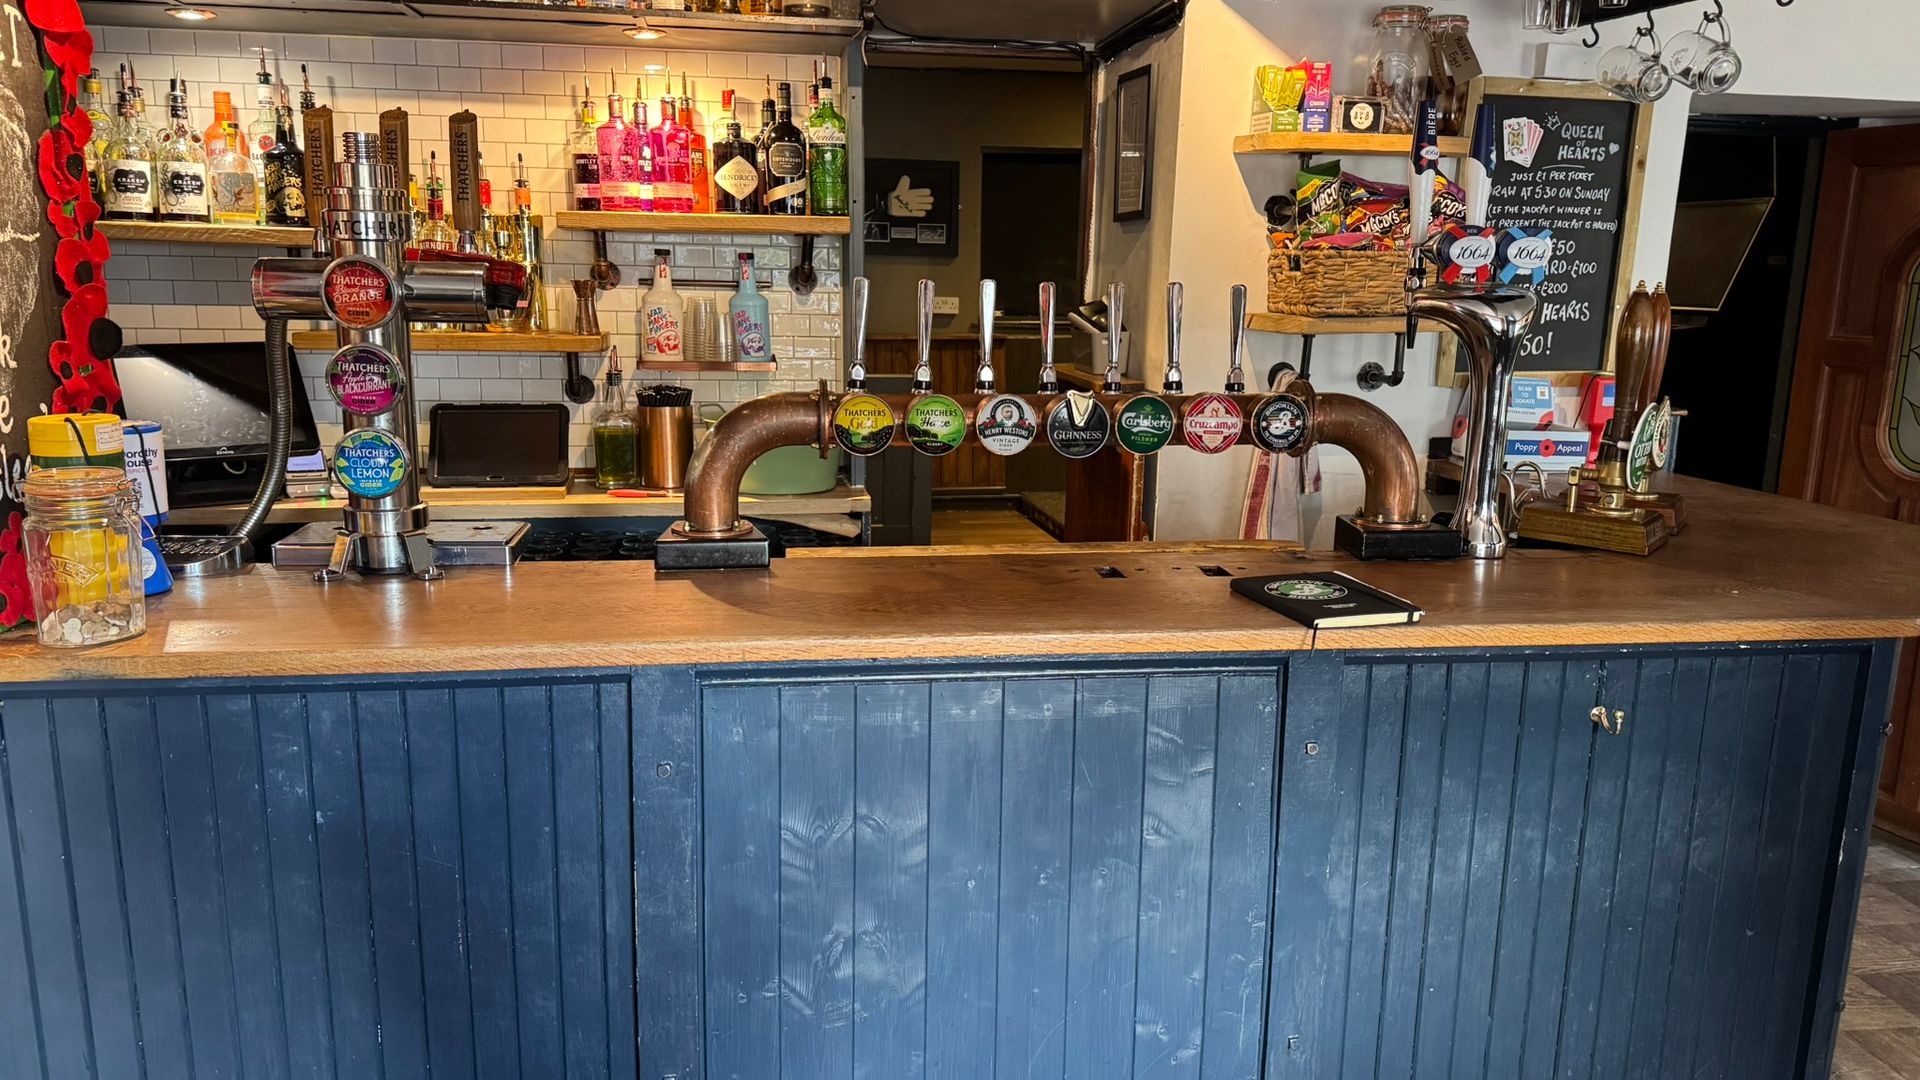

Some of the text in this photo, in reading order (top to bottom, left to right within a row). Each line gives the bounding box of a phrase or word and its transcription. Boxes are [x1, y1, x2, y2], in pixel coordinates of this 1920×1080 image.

[1561, 122, 1604, 140] QUEEN
[1558, 146, 1606, 162] HEARTS
[312, 126, 323, 198] THATCHERS
[456, 131, 469, 202] THATCHERS
[1510, 170, 1595, 182] JUST £1 PER TICKET
[1491, 184, 1517, 197] RAW
[1520, 186, 1534, 201] AT
[1559, 188, 1573, 199] ON
[1574, 186, 1611, 202] SUNDAY
[1504, 205, 1519, 213] THE
[1521, 205, 1554, 214] JACKPOT
[1557, 205, 1591, 216] WINNER
[323, 218, 406, 238] HATCHERS
[1498, 218, 1536, 228] PRESENT
[1538, 219, 1550, 228] THE
[1456, 244, 1490, 260] 1664
[1513, 245, 1547, 261] 1664
[332, 274, 385, 287] THATCHERS
[334, 290, 383, 304] ORANGE
[1540, 299, 1591, 325] HEARTS
[1520, 331, 1554, 357] 50!
[337, 361, 391, 374] THATCHERS
[337, 379, 391, 395] BLACKCURRANT
[844, 409, 886, 417] THATCHERS
[916, 409, 958, 417] THATCHERS
[1265, 402, 1298, 416] BROOKLYN
[1121, 412, 1172, 431] Carlsberg
[1189, 418, 1240, 431] Cruzcampo
[985, 426, 1029, 437] HENRY WESTONS
[1054, 430, 1103, 440] GUINNESS
[126, 447, 158, 460] orothy
[344, 447, 395, 458] THATCHERS
[1514, 442, 1583, 454] Poppy Appeal
[127, 458, 153, 468] ouse
[350, 457, 389, 468] CLOUDY
[351, 468, 390, 479] LEMON
